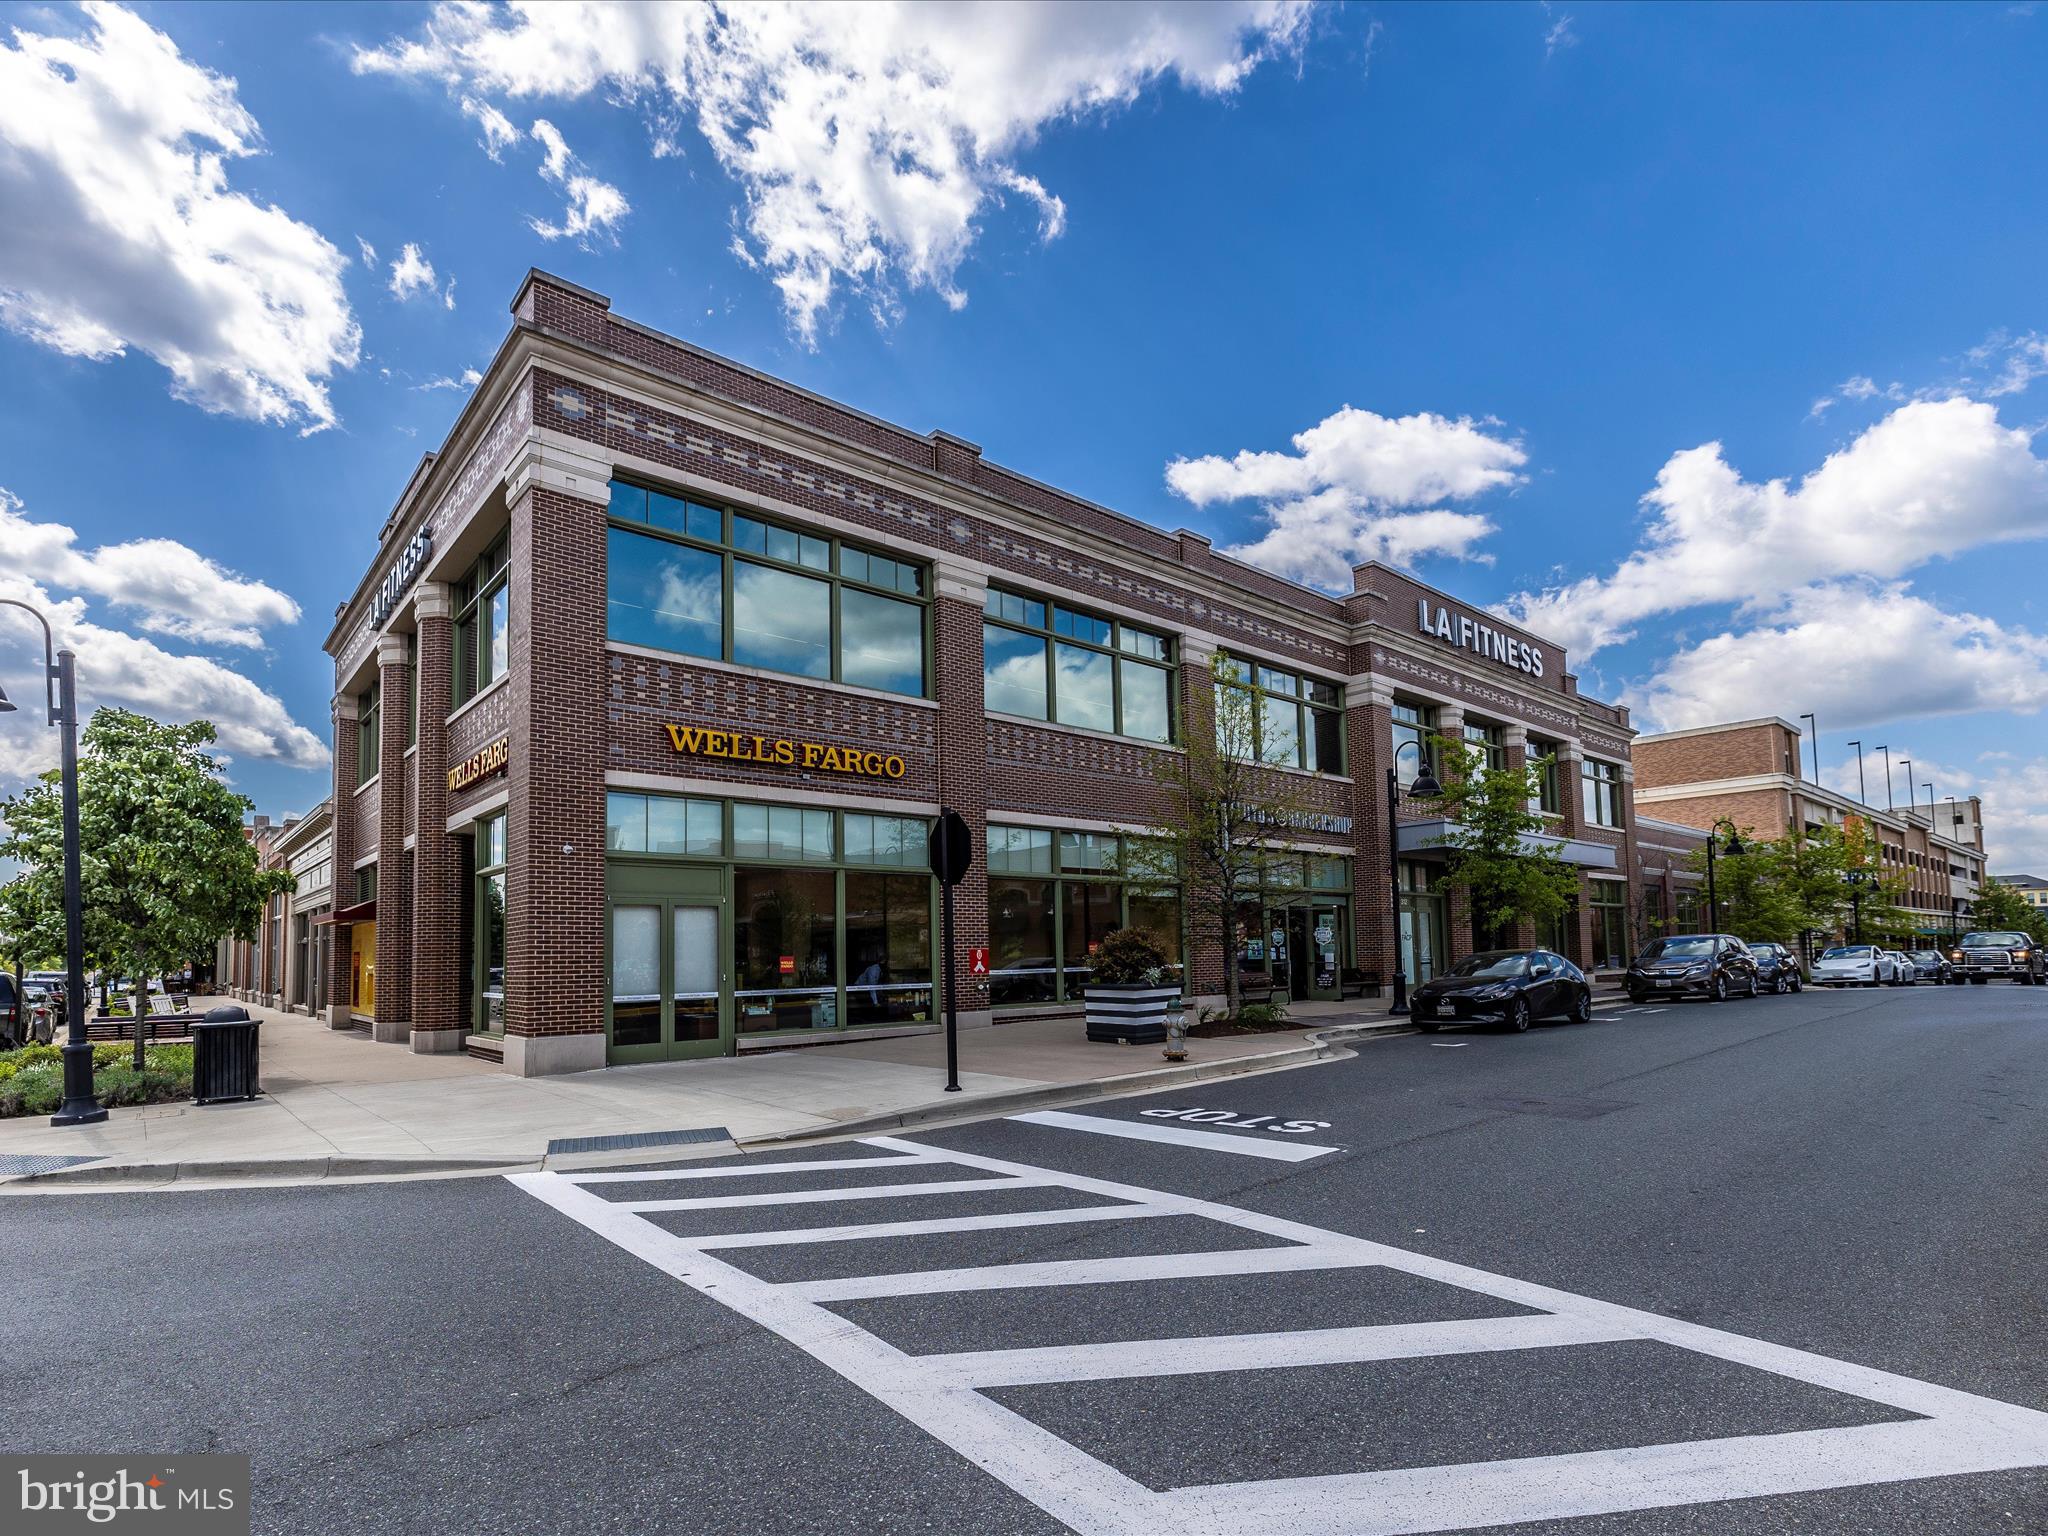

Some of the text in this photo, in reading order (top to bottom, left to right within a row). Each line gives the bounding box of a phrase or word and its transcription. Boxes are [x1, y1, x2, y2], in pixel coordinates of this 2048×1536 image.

[368, 525, 428, 630] LA FITNESS
[1419, 600, 1544, 678] LA FITNESS
[448, 754, 480, 791] WELLS
[666, 724, 906, 778] WELLS FARGO
[1140, 1108, 1332, 1133] STOP
